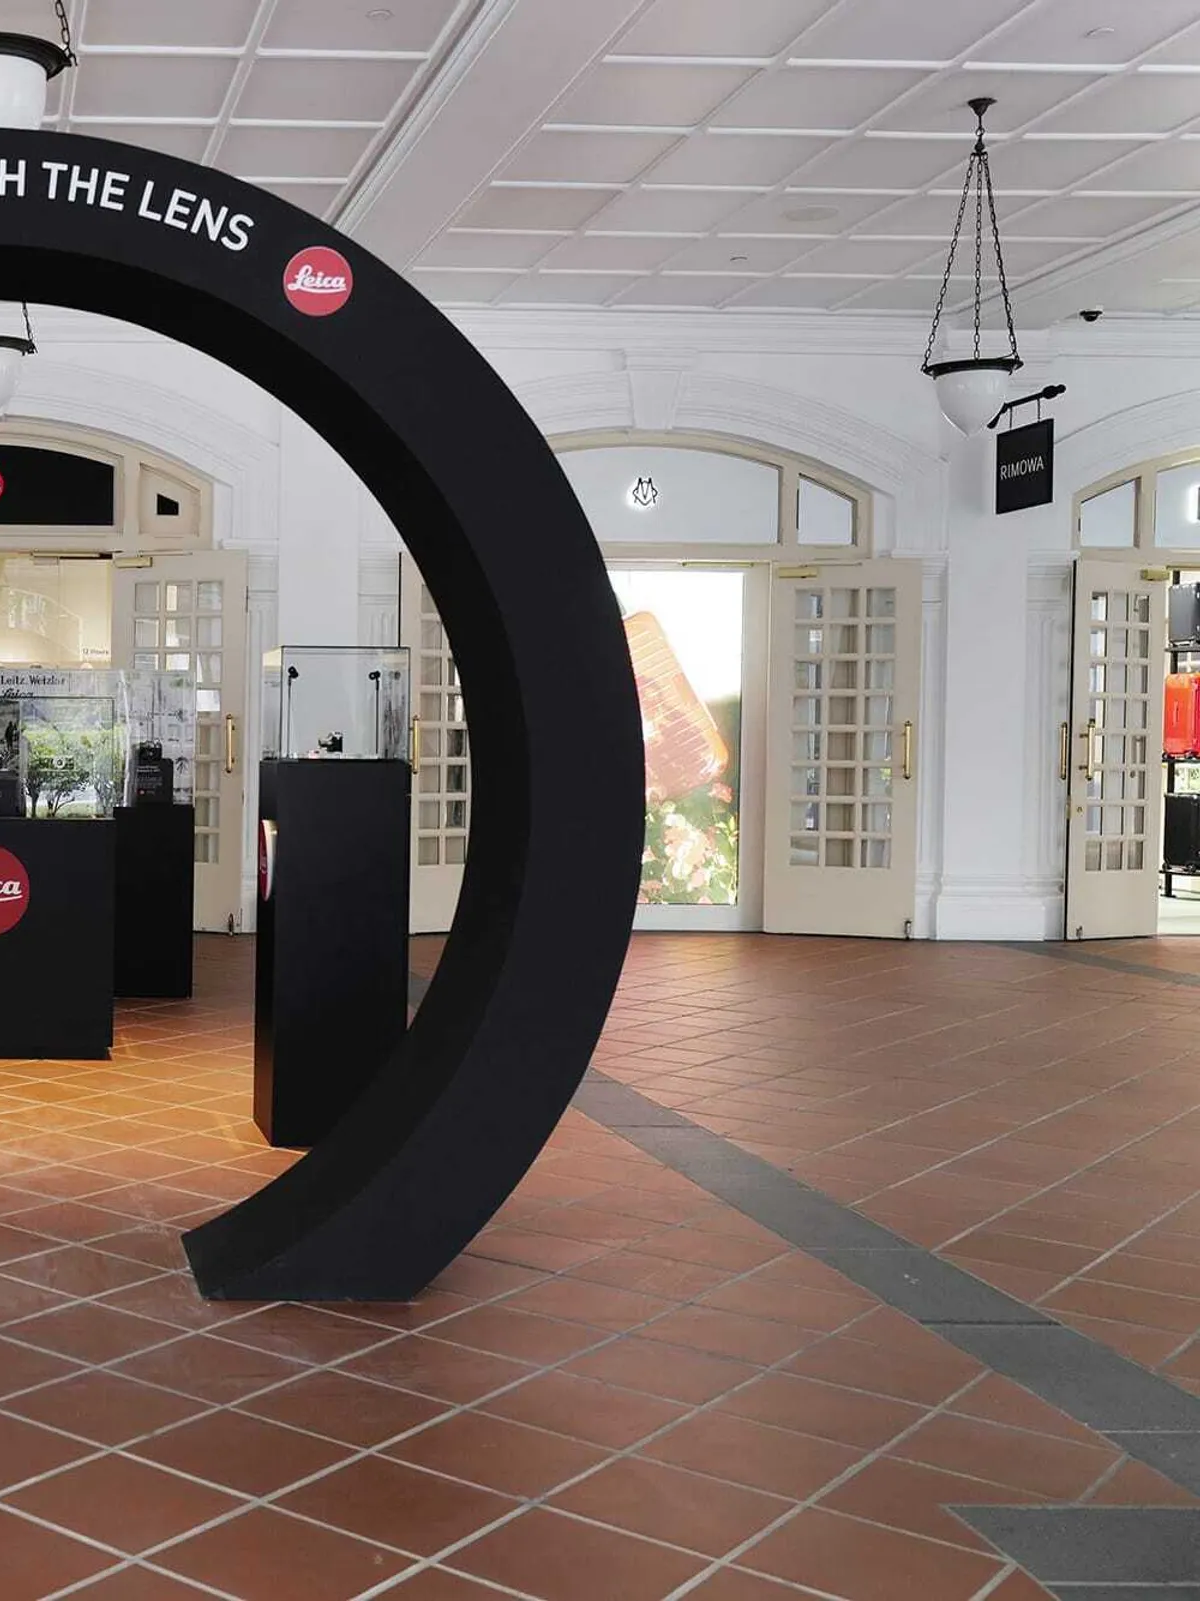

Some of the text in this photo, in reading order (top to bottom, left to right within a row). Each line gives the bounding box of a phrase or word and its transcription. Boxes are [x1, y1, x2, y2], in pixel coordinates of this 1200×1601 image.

[41, 161, 130, 211] THE
[138, 180, 255, 251] LENS
[287, 264, 347, 294] Leica
[1000, 455, 1045, 480] RIMOWA
